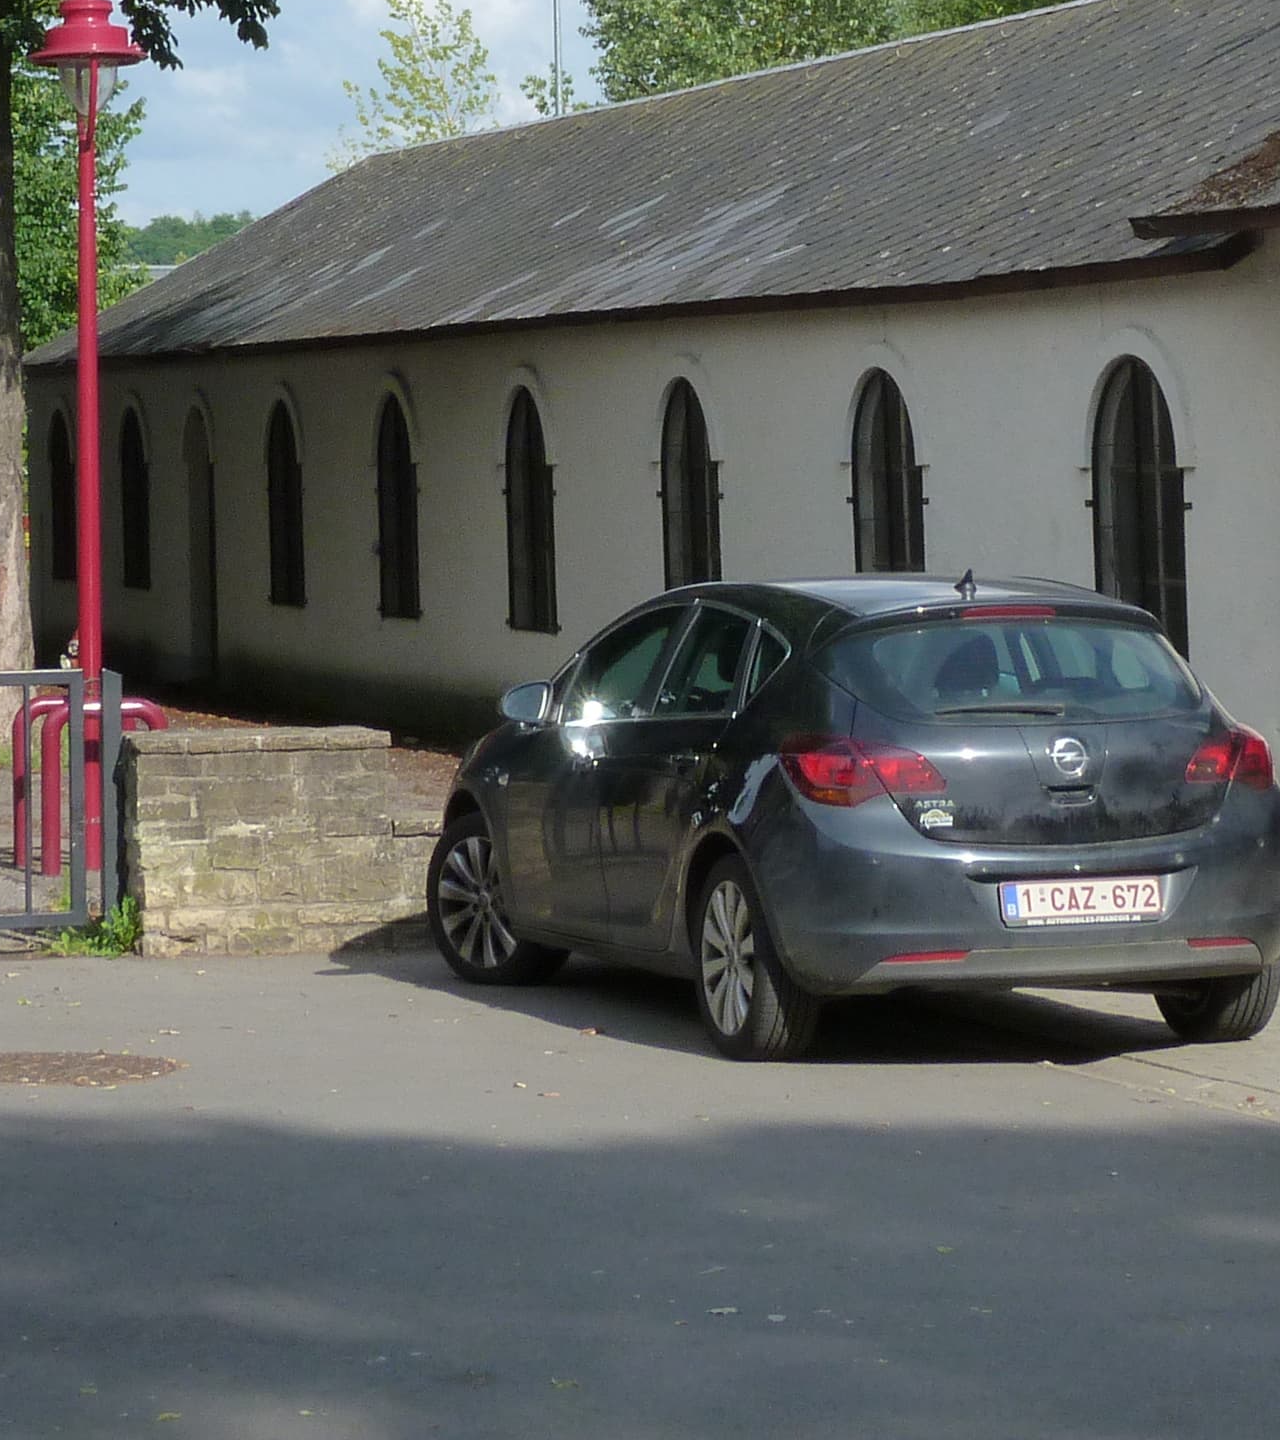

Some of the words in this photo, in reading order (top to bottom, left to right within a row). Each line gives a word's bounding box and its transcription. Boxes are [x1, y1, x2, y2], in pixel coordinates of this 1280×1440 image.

[914, 799, 956, 809] ASTRA
[1022, 884, 1157, 912] 1-CAZ-672
[1007, 904, 1017, 916] B
